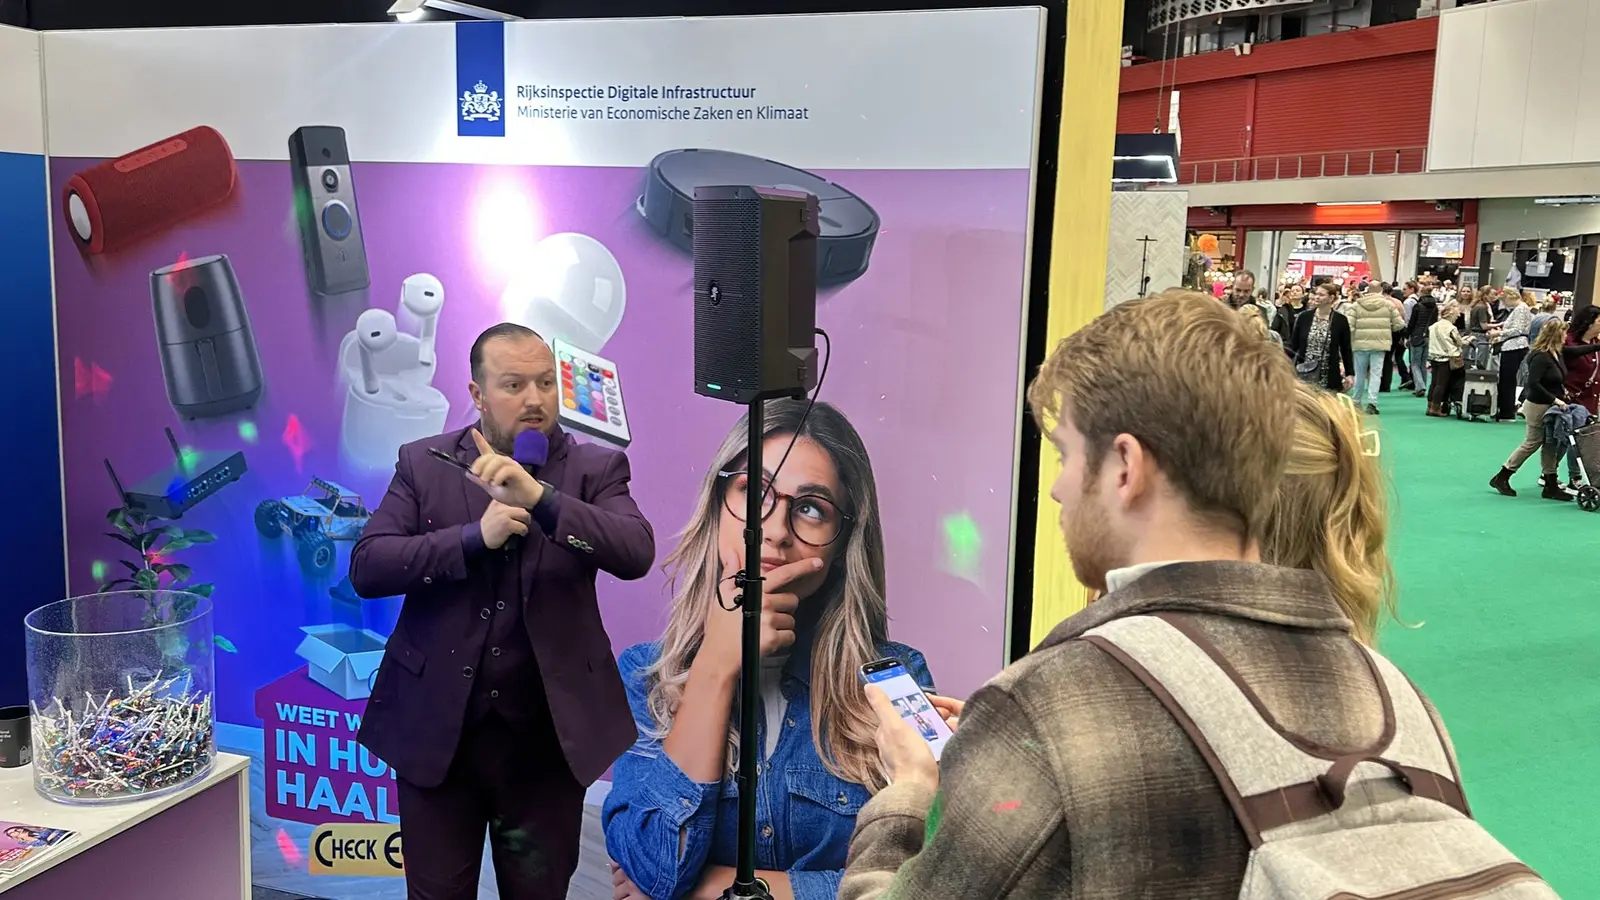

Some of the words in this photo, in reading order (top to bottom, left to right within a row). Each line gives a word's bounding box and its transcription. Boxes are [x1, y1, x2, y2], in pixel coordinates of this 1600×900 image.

[517, 85, 604, 101] Rijksinspectie
[608, 85, 658, 101] Digitale
[662, 86, 756, 99] Infrastructuur
[517, 105, 578, 119] Ministerie
[581, 109, 603, 119] van
[607, 106, 690, 120] Economische
[693, 107, 732, 120] Zaken
[736, 109, 753, 120] en
[757, 106, 809, 120] Klimaat
[275, 702, 339, 728] WEET
[276, 728, 316, 767] IN
[329, 736, 397, 779] HU
[276, 769, 400, 825] HAAL
[384, 830, 403, 869] E
